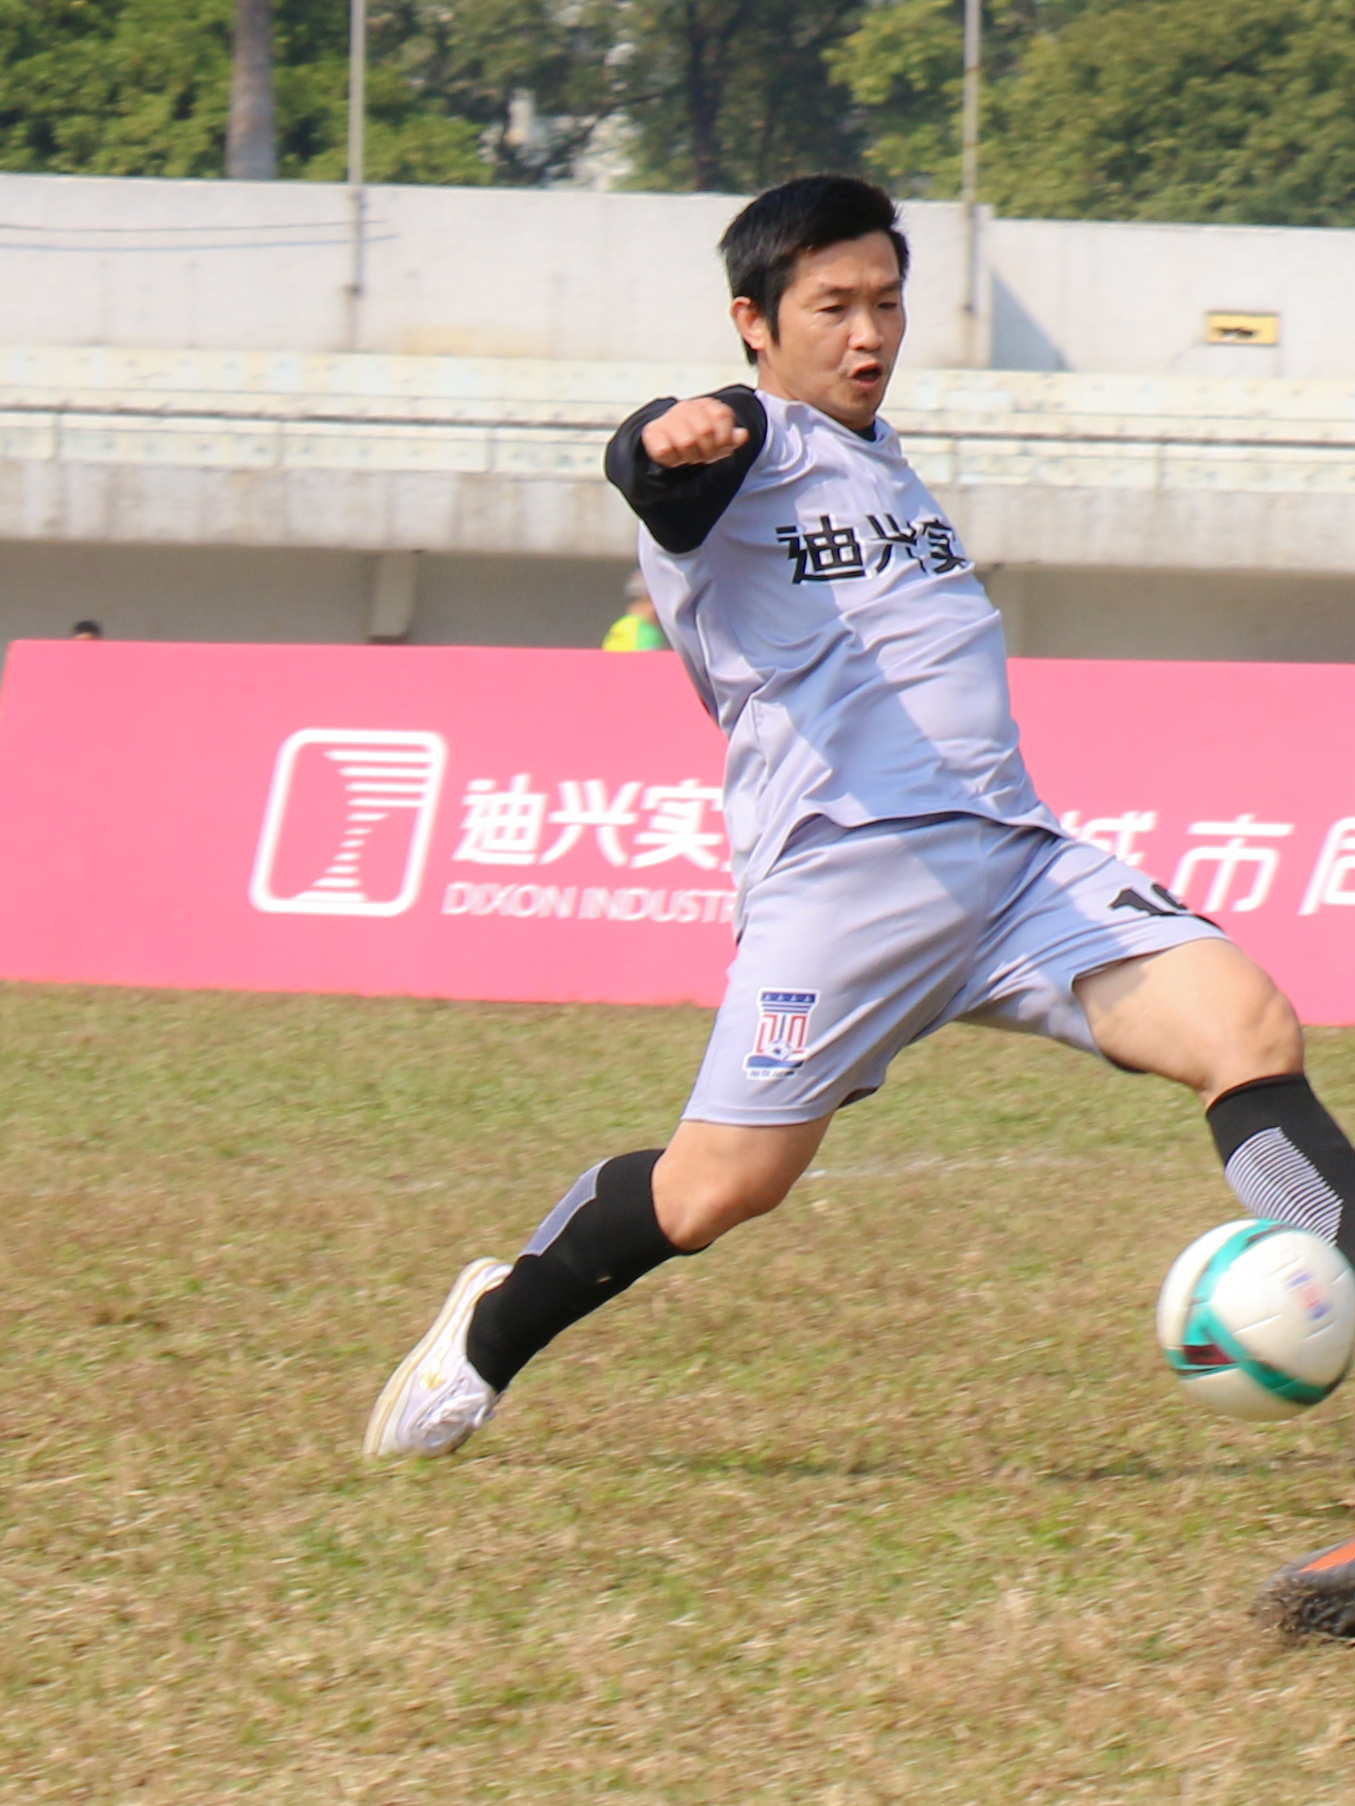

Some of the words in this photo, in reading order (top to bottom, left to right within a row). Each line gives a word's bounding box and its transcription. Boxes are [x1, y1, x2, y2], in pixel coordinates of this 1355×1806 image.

[452, 773, 732, 872] 迪兴实
[441, 881, 571, 919] DIXON
